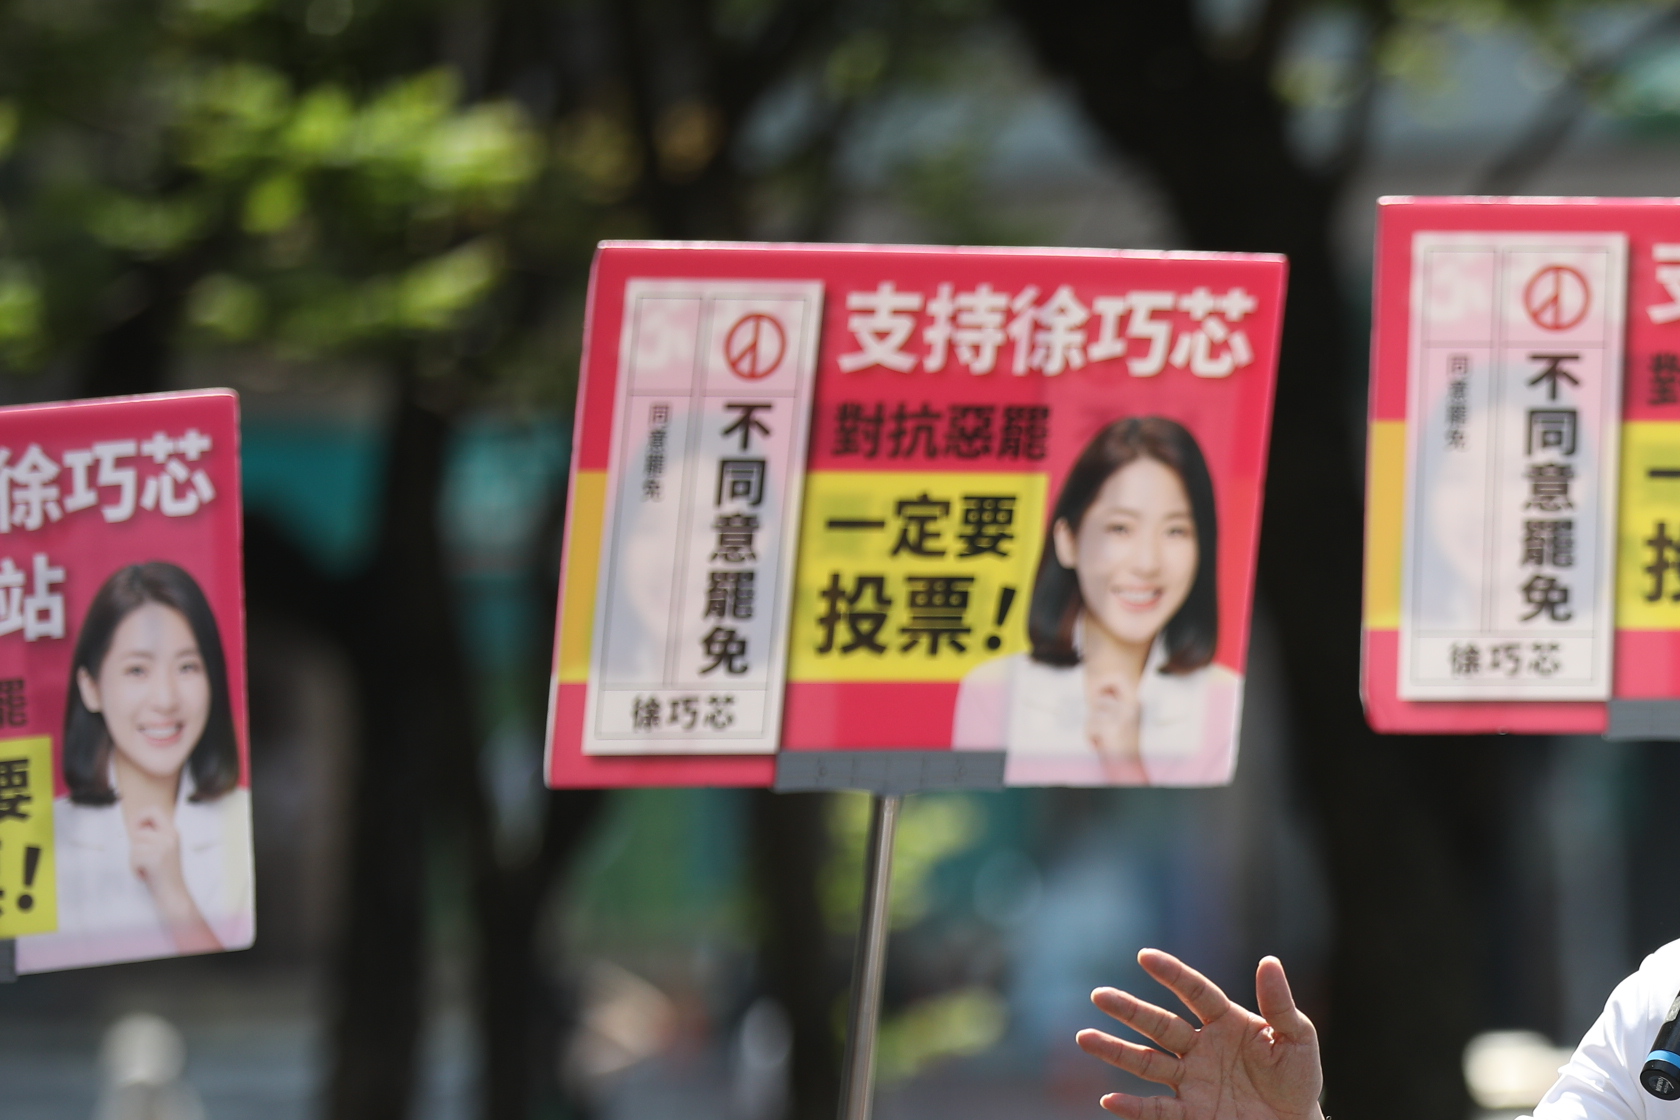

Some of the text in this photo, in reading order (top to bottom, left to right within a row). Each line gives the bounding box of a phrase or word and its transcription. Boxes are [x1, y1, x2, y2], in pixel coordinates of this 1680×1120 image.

[838, 281, 1257, 378] 支持徐巧芯
[832, 405, 1051, 461] 對抗惡罷
[0, 429, 215, 534] 徐巧芯
[1519, 354, 1582, 624] 不同意罷免
[698, 403, 773, 677] 不同意罷免
[826, 493, 1018, 560] 一定要
[815, 572, 1017, 658] 投票!
[1450, 642, 1564, 679] 徐巧芯
[631, 697, 737, 732] 徐巧芯
